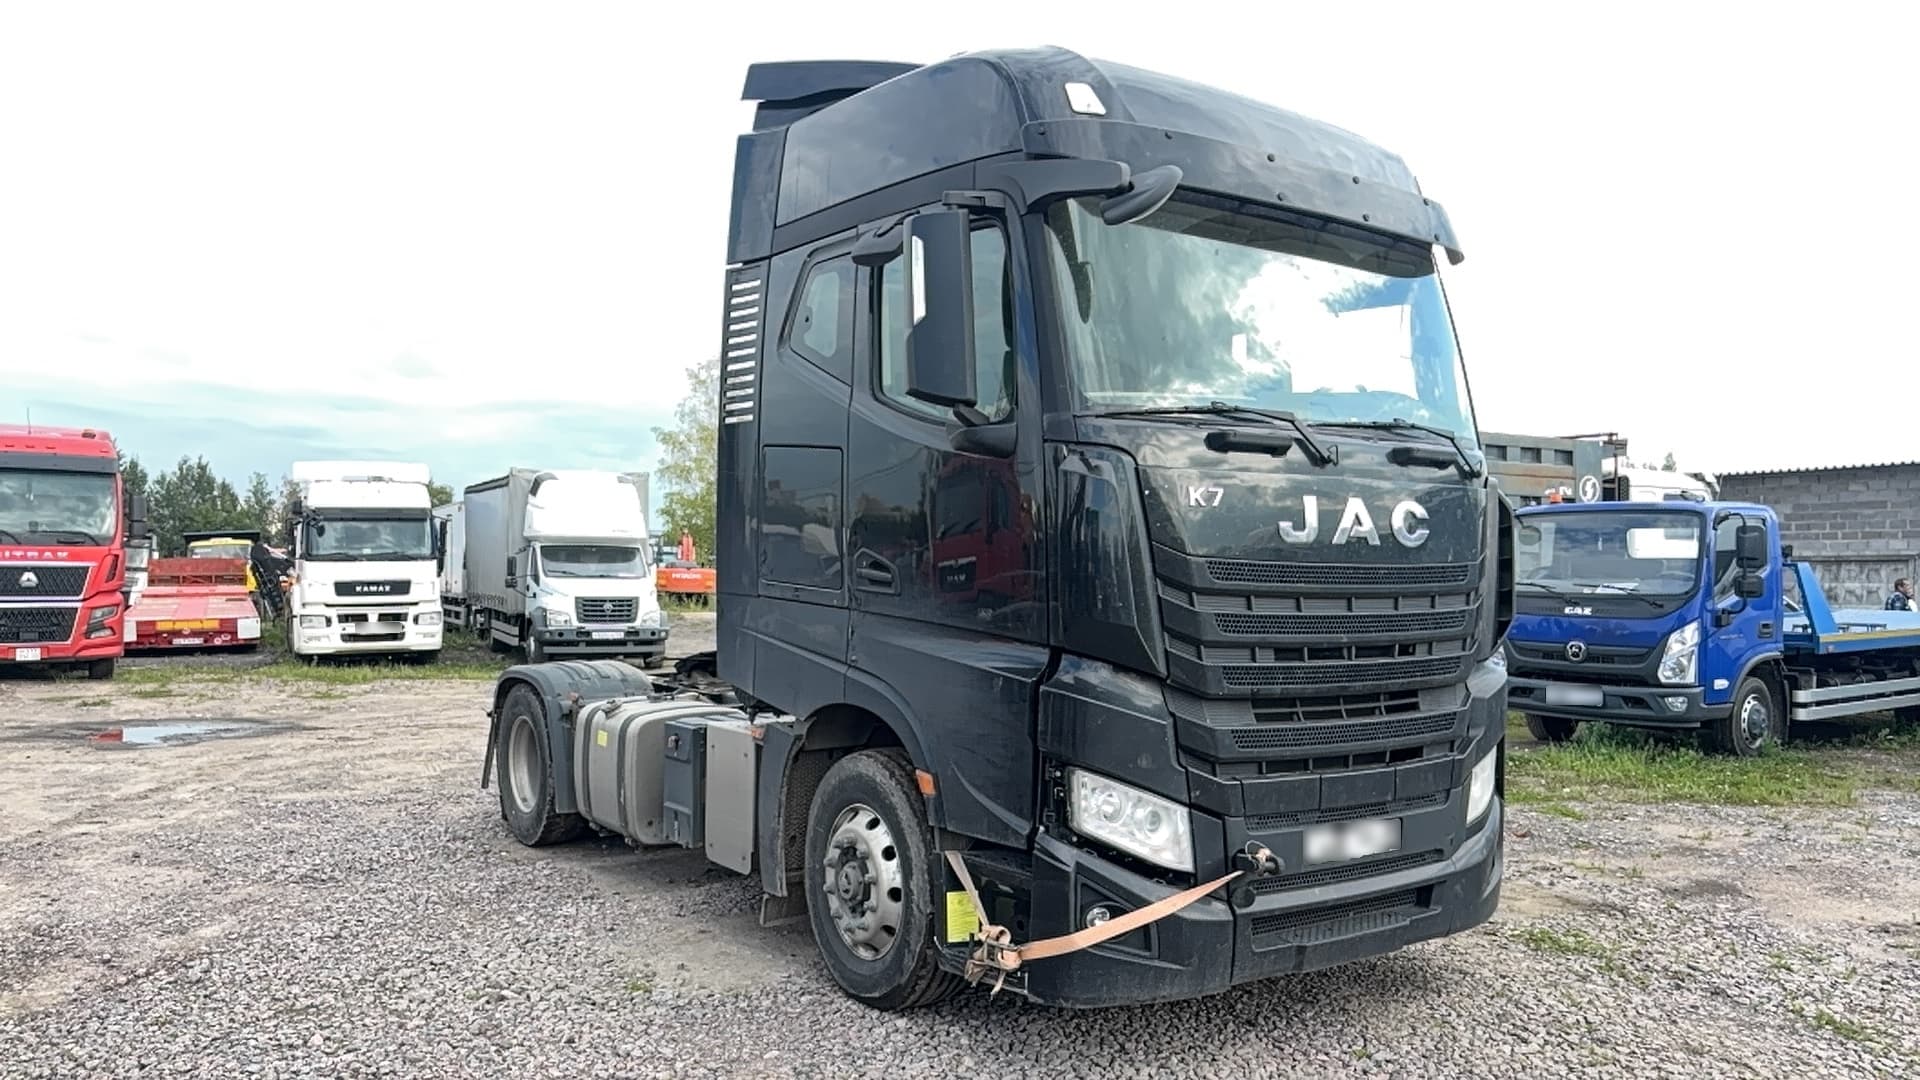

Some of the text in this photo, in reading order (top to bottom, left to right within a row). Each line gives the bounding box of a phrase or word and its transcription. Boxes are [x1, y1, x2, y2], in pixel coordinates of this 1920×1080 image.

[1187, 487, 1224, 507] K7
[1278, 495, 1431, 548] JAC
[0, 550, 70, 560] ITRAK
[354, 584, 391, 593] KAMAZ
[1564, 606, 1593, 616] GAZ
